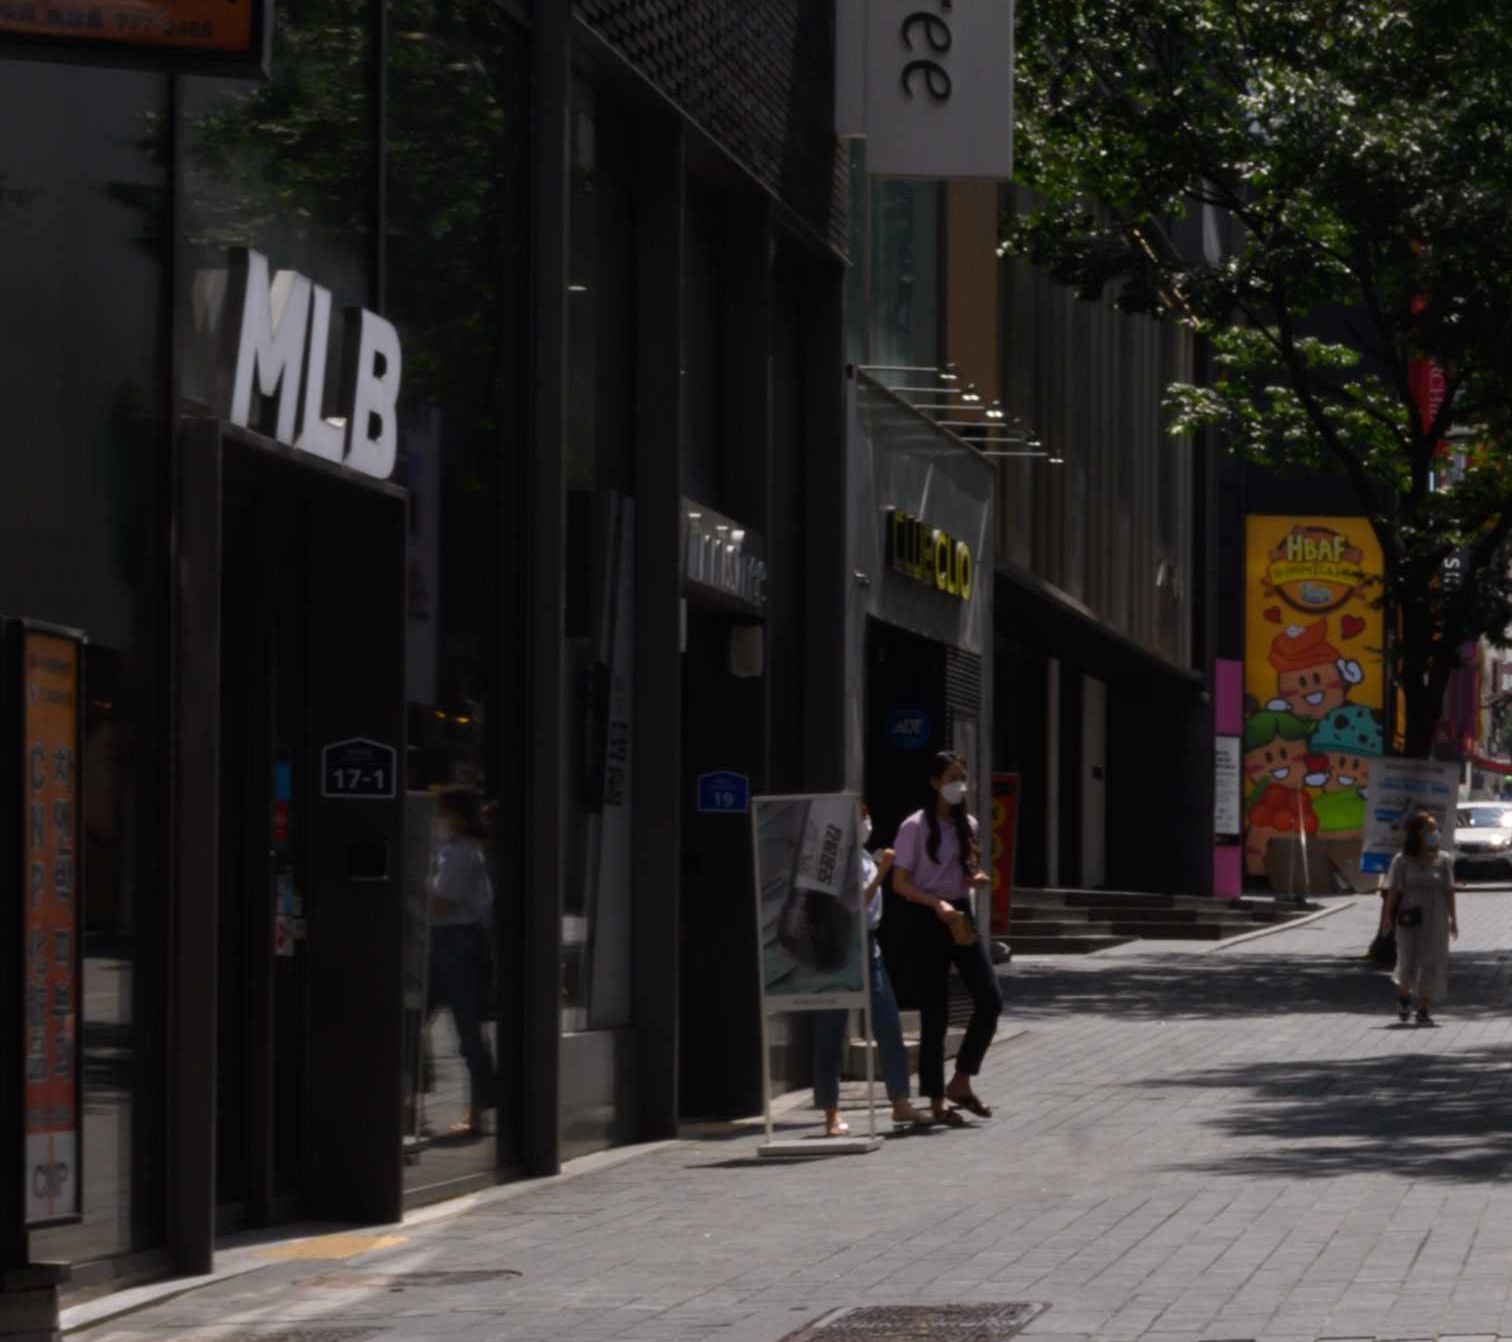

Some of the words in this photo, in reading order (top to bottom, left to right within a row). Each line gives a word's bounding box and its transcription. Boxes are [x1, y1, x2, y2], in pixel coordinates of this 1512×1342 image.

[230, 247, 402, 481] MLB
[332, 768, 385, 790] 17-1
[711, 789, 735, 808] 19
